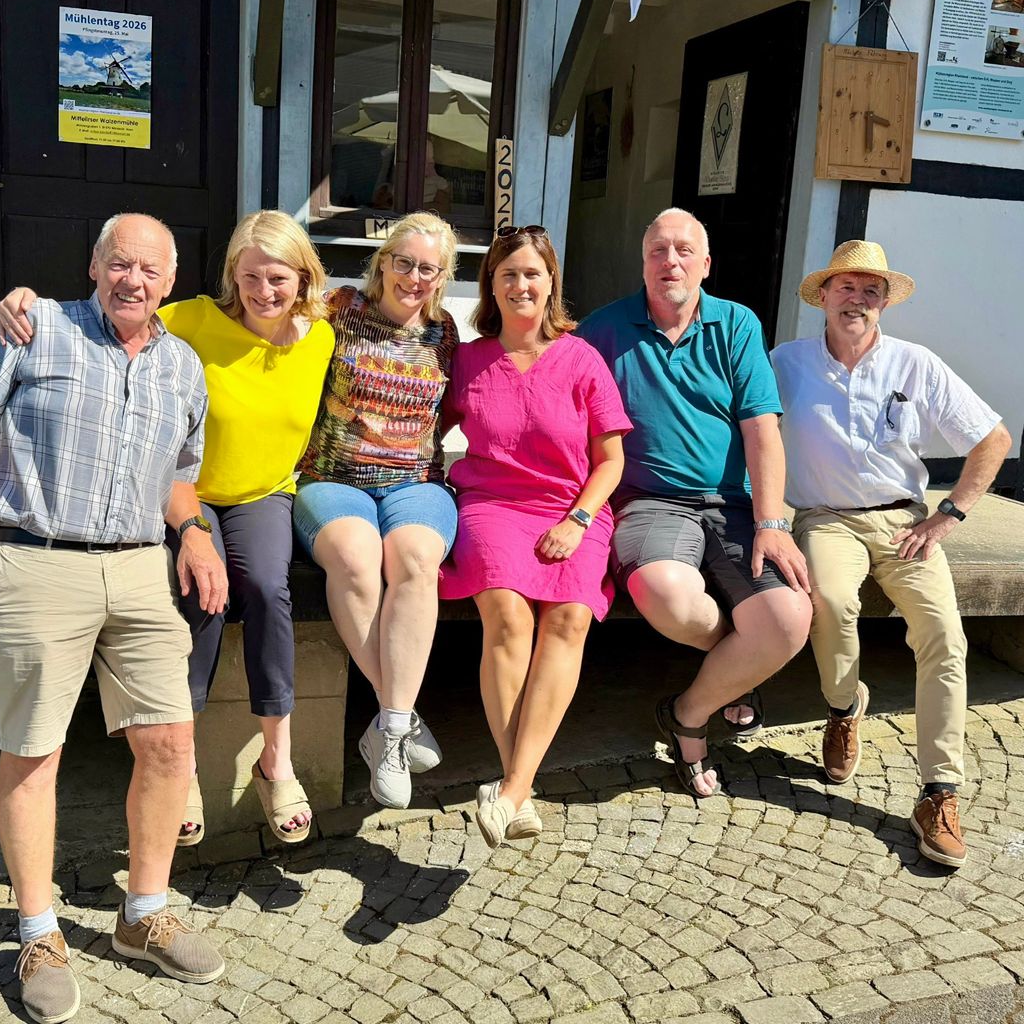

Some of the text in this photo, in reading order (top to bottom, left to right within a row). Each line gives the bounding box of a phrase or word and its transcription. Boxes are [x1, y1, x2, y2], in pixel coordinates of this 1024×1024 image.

[65, 13, 147, 30] Mühlentag 2026
[71, 115, 139, 126] Mittelirser Walzenmühle
